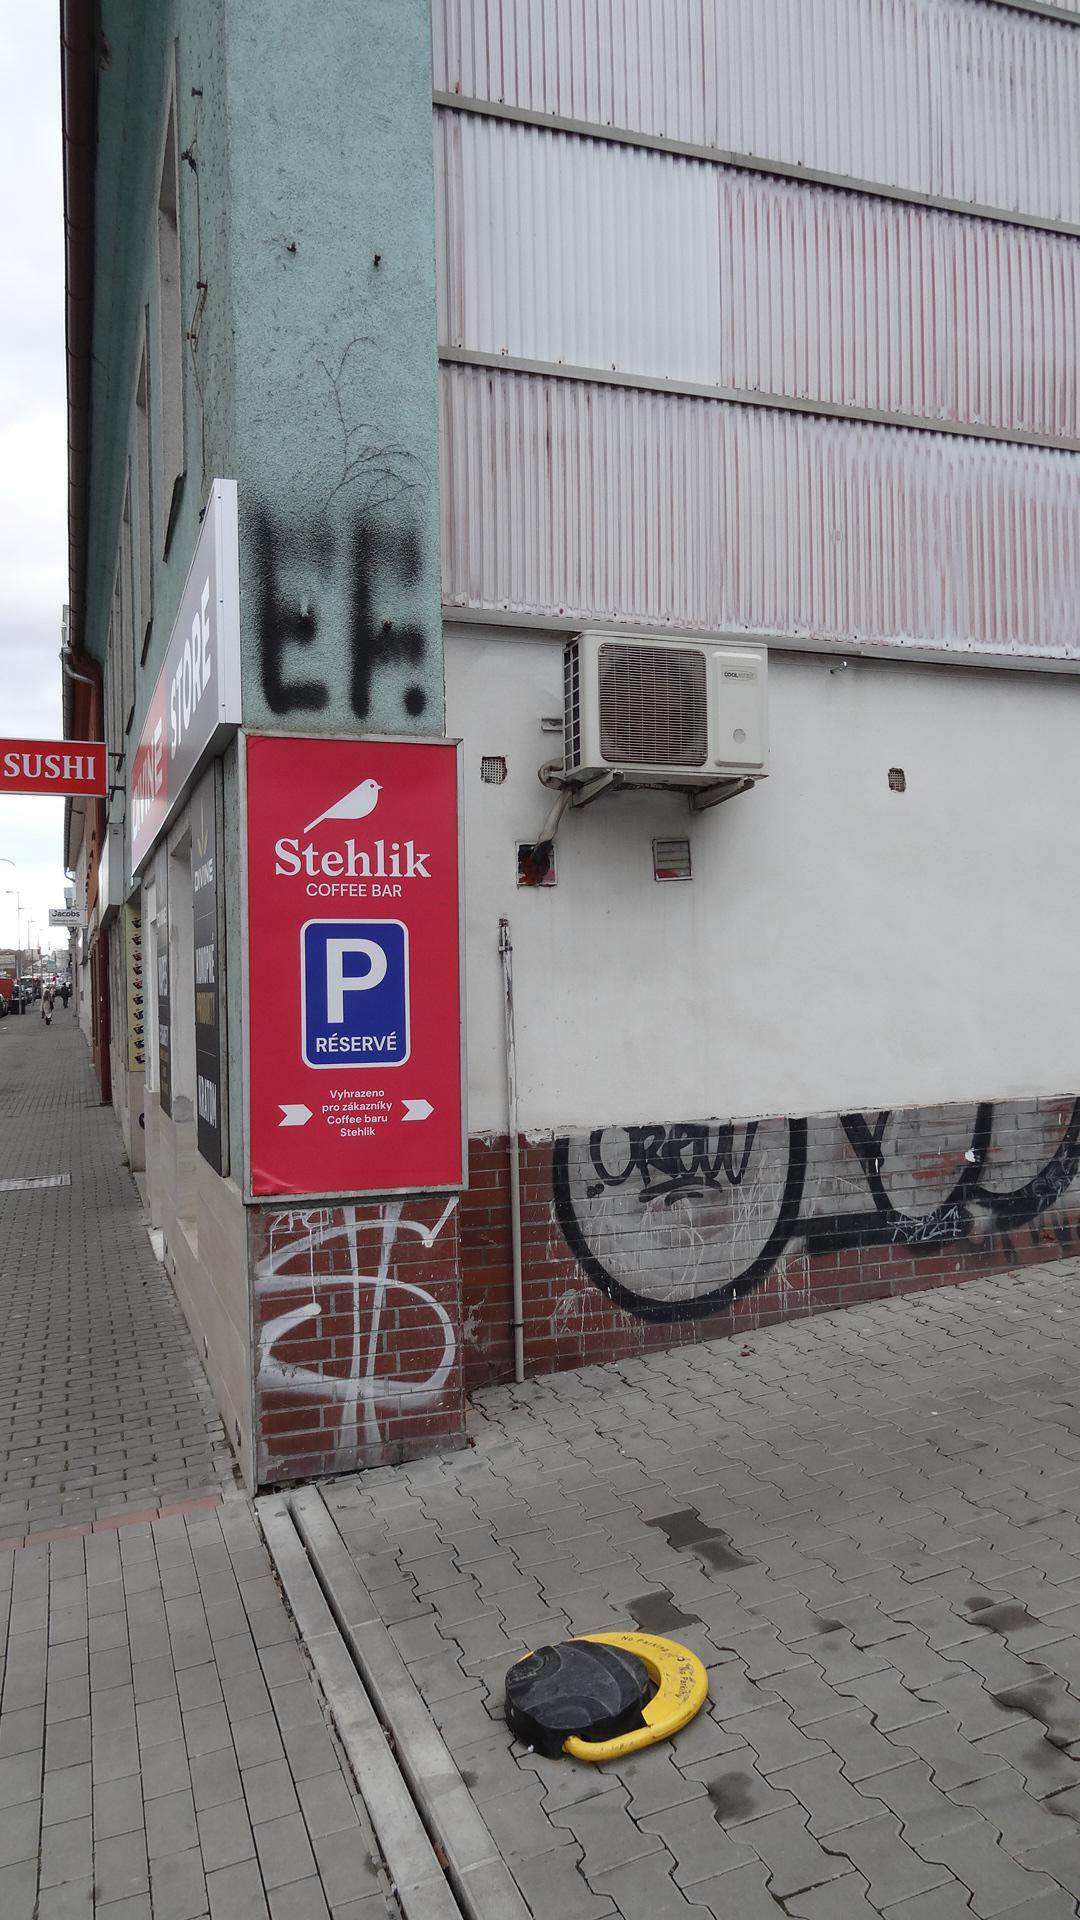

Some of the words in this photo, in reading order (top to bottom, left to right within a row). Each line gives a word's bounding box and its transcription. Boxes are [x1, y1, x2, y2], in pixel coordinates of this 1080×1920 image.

[170, 575, 212, 761] STORE
[3, 752, 97, 780] SUSHI
[274, 837, 432, 878] Stehlik
[306, 882, 368, 897] COFFEE
[371, 884, 402, 897] BAR
[51, 910, 81, 918] Jacobs
[325, 938, 388, 1024] P
[315, 1031, 398, 1053] RÉSERVÉ
[329, 1089, 385, 1101] Vyhrazeno
[322, 1104, 340, 1114] pro
[342, 1100, 393, 1111] zákazníky
[327, 1114, 362, 1125] Coffee
[364, 1113, 388, 1123] baru
[340, 1126, 376, 1137] Stehlik
[638, 1638, 670, 1653] Parking
